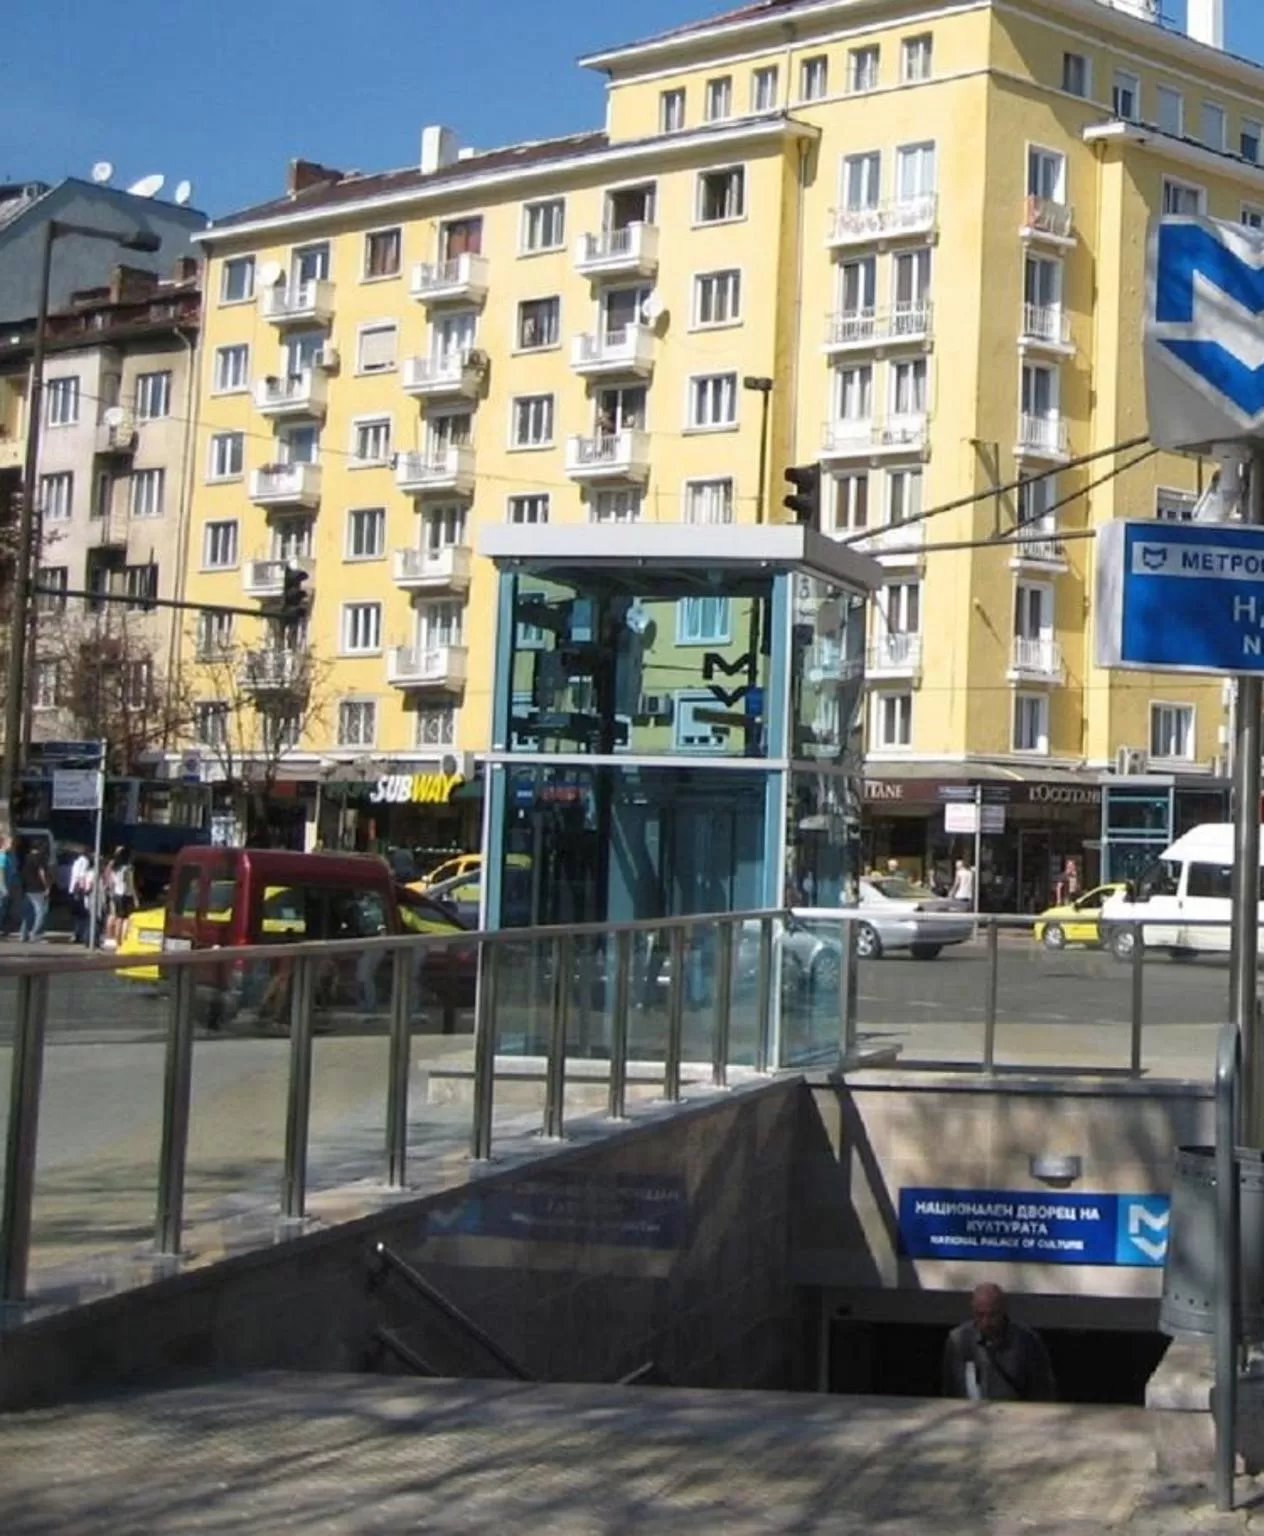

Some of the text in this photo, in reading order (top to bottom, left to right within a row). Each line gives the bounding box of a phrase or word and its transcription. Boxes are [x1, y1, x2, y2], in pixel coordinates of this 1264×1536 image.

[369, 772, 464, 803] SUBWAY
[915, 1201, 1100, 1220] НАЦИОНАЛЕН ДВОРЕЦ НА
[966, 1220, 1048, 1235] КУЛТУРАТА
[930, 1235, 1084, 1251] NATIONAL PALACE OF CULTURE
